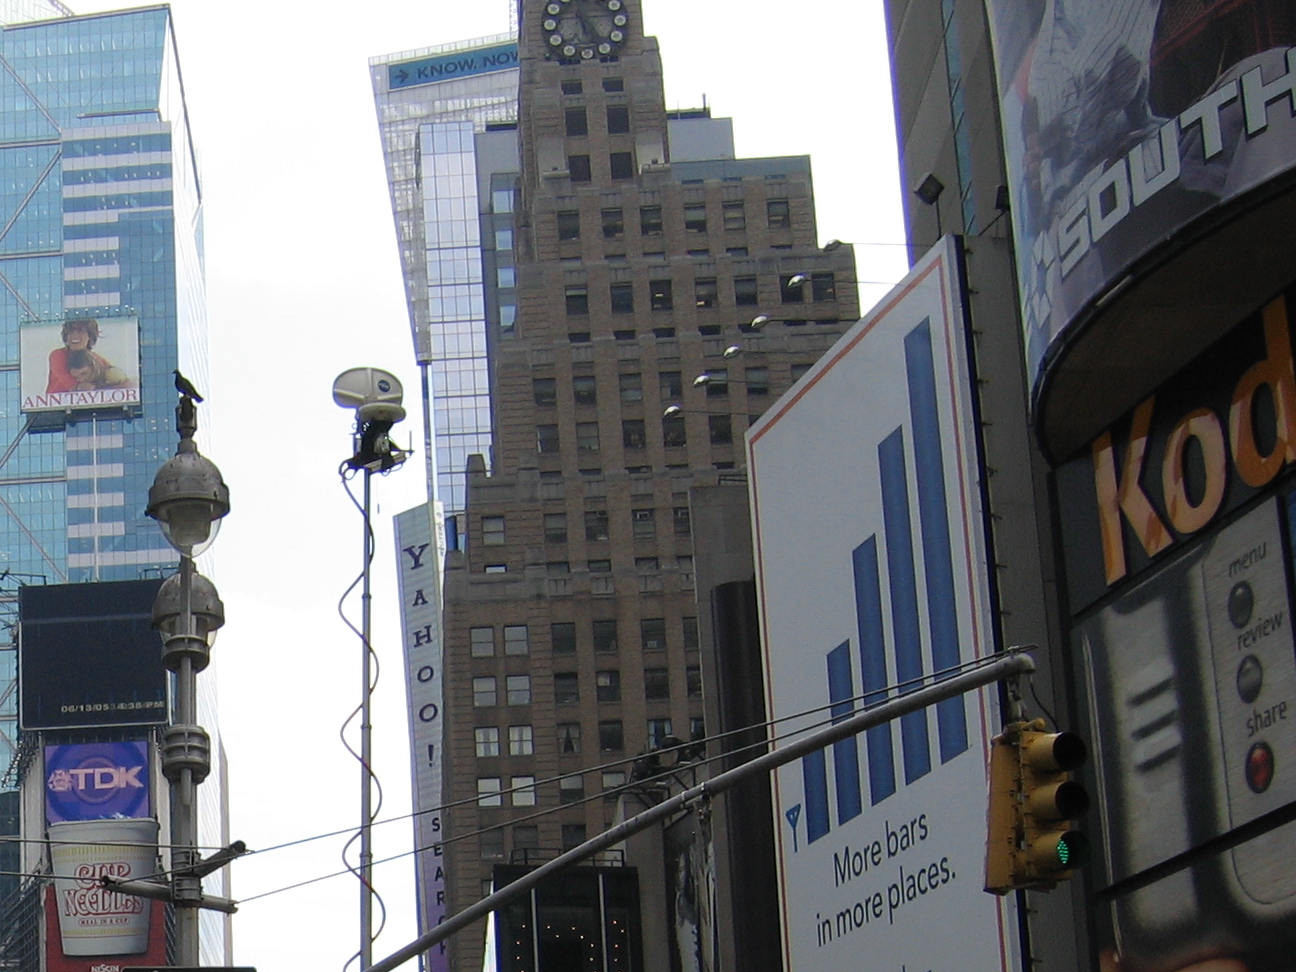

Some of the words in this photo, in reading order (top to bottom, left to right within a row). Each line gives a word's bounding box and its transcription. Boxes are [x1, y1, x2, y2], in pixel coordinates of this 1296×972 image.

[417, 58, 477, 79] KNOW.
[23, 394, 62, 407] ANN
[64, 389, 138, 404] TAYLOR
[1228, 541, 1267, 577] menu
[1237, 611, 1283, 651] review
[1247, 701, 1288, 738] share
[71, 765, 144, 791] TDK
[834, 840, 881, 887] More
[885, 813, 929, 858] bars
[817, 913, 833, 947] in
[837, 892, 883, 938] more
[888, 857, 956, 925] places.
